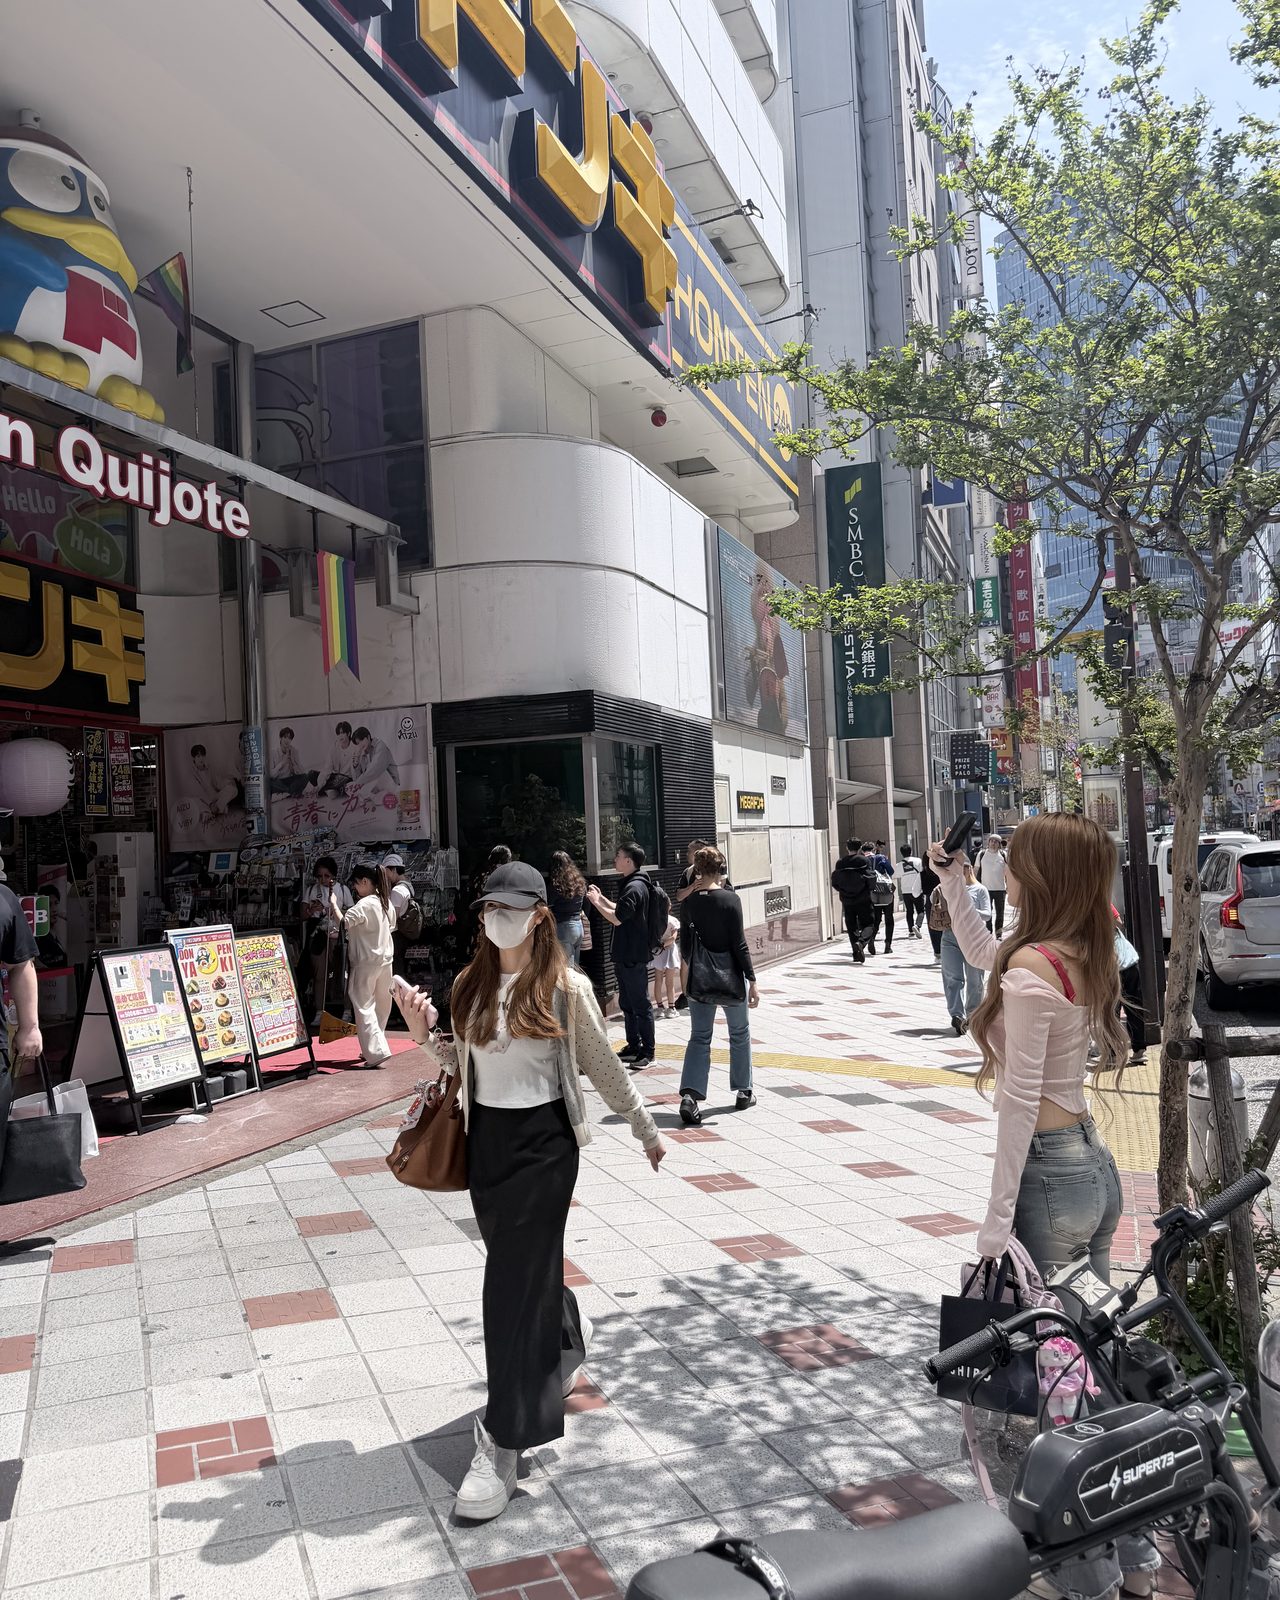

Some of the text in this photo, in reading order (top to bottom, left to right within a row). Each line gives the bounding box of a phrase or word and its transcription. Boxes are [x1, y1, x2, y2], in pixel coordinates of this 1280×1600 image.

[59, 426, 250, 537] Quijote
[2, 485, 56, 514] Hello
[70, 525, 111, 565] Hola
[847, 508, 864, 577] SMBC
[23, 910, 48, 924] CB
[179, 948, 194, 961] DON
[217, 943, 232, 954] PEN
[181, 962, 198, 979] YA
[220, 956, 234, 972] KI
[1122, 1451, 1175, 1485] SUPER73
